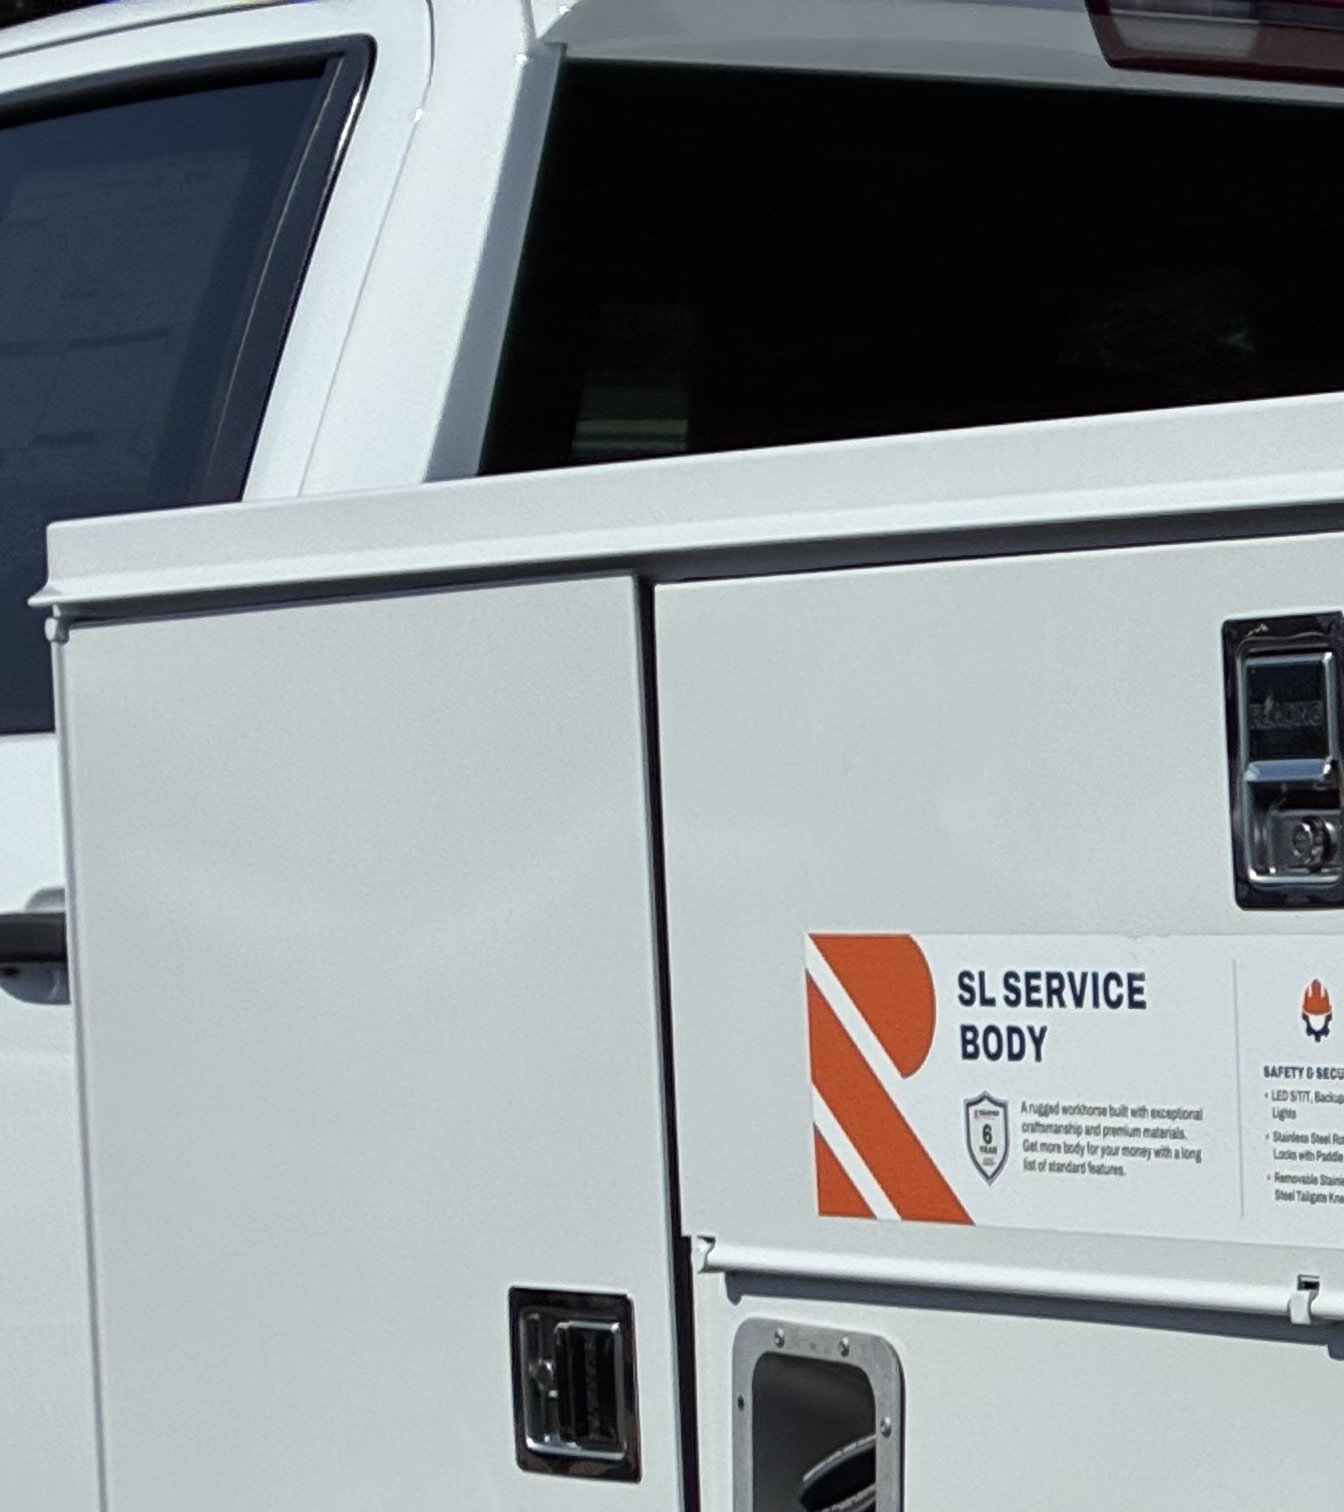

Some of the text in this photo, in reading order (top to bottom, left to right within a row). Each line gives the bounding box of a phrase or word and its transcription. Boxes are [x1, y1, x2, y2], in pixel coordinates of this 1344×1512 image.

[958, 970, 1147, 1010] SL SERVICE
[960, 1024, 1048, 1062] BODY
[1264, 1066, 1304, 1079] SAFETY
[1020, 1101, 1203, 1122] A rugged workhorse built with exceptional
[982, 1123, 993, 1145] 6
[1021, 1121, 1187, 1140] craftsmanship and premium materials.
[1023, 1139, 1202, 1164] Get more body for your money with a long
[1023, 1158, 1126, 1176] list of standard features.
